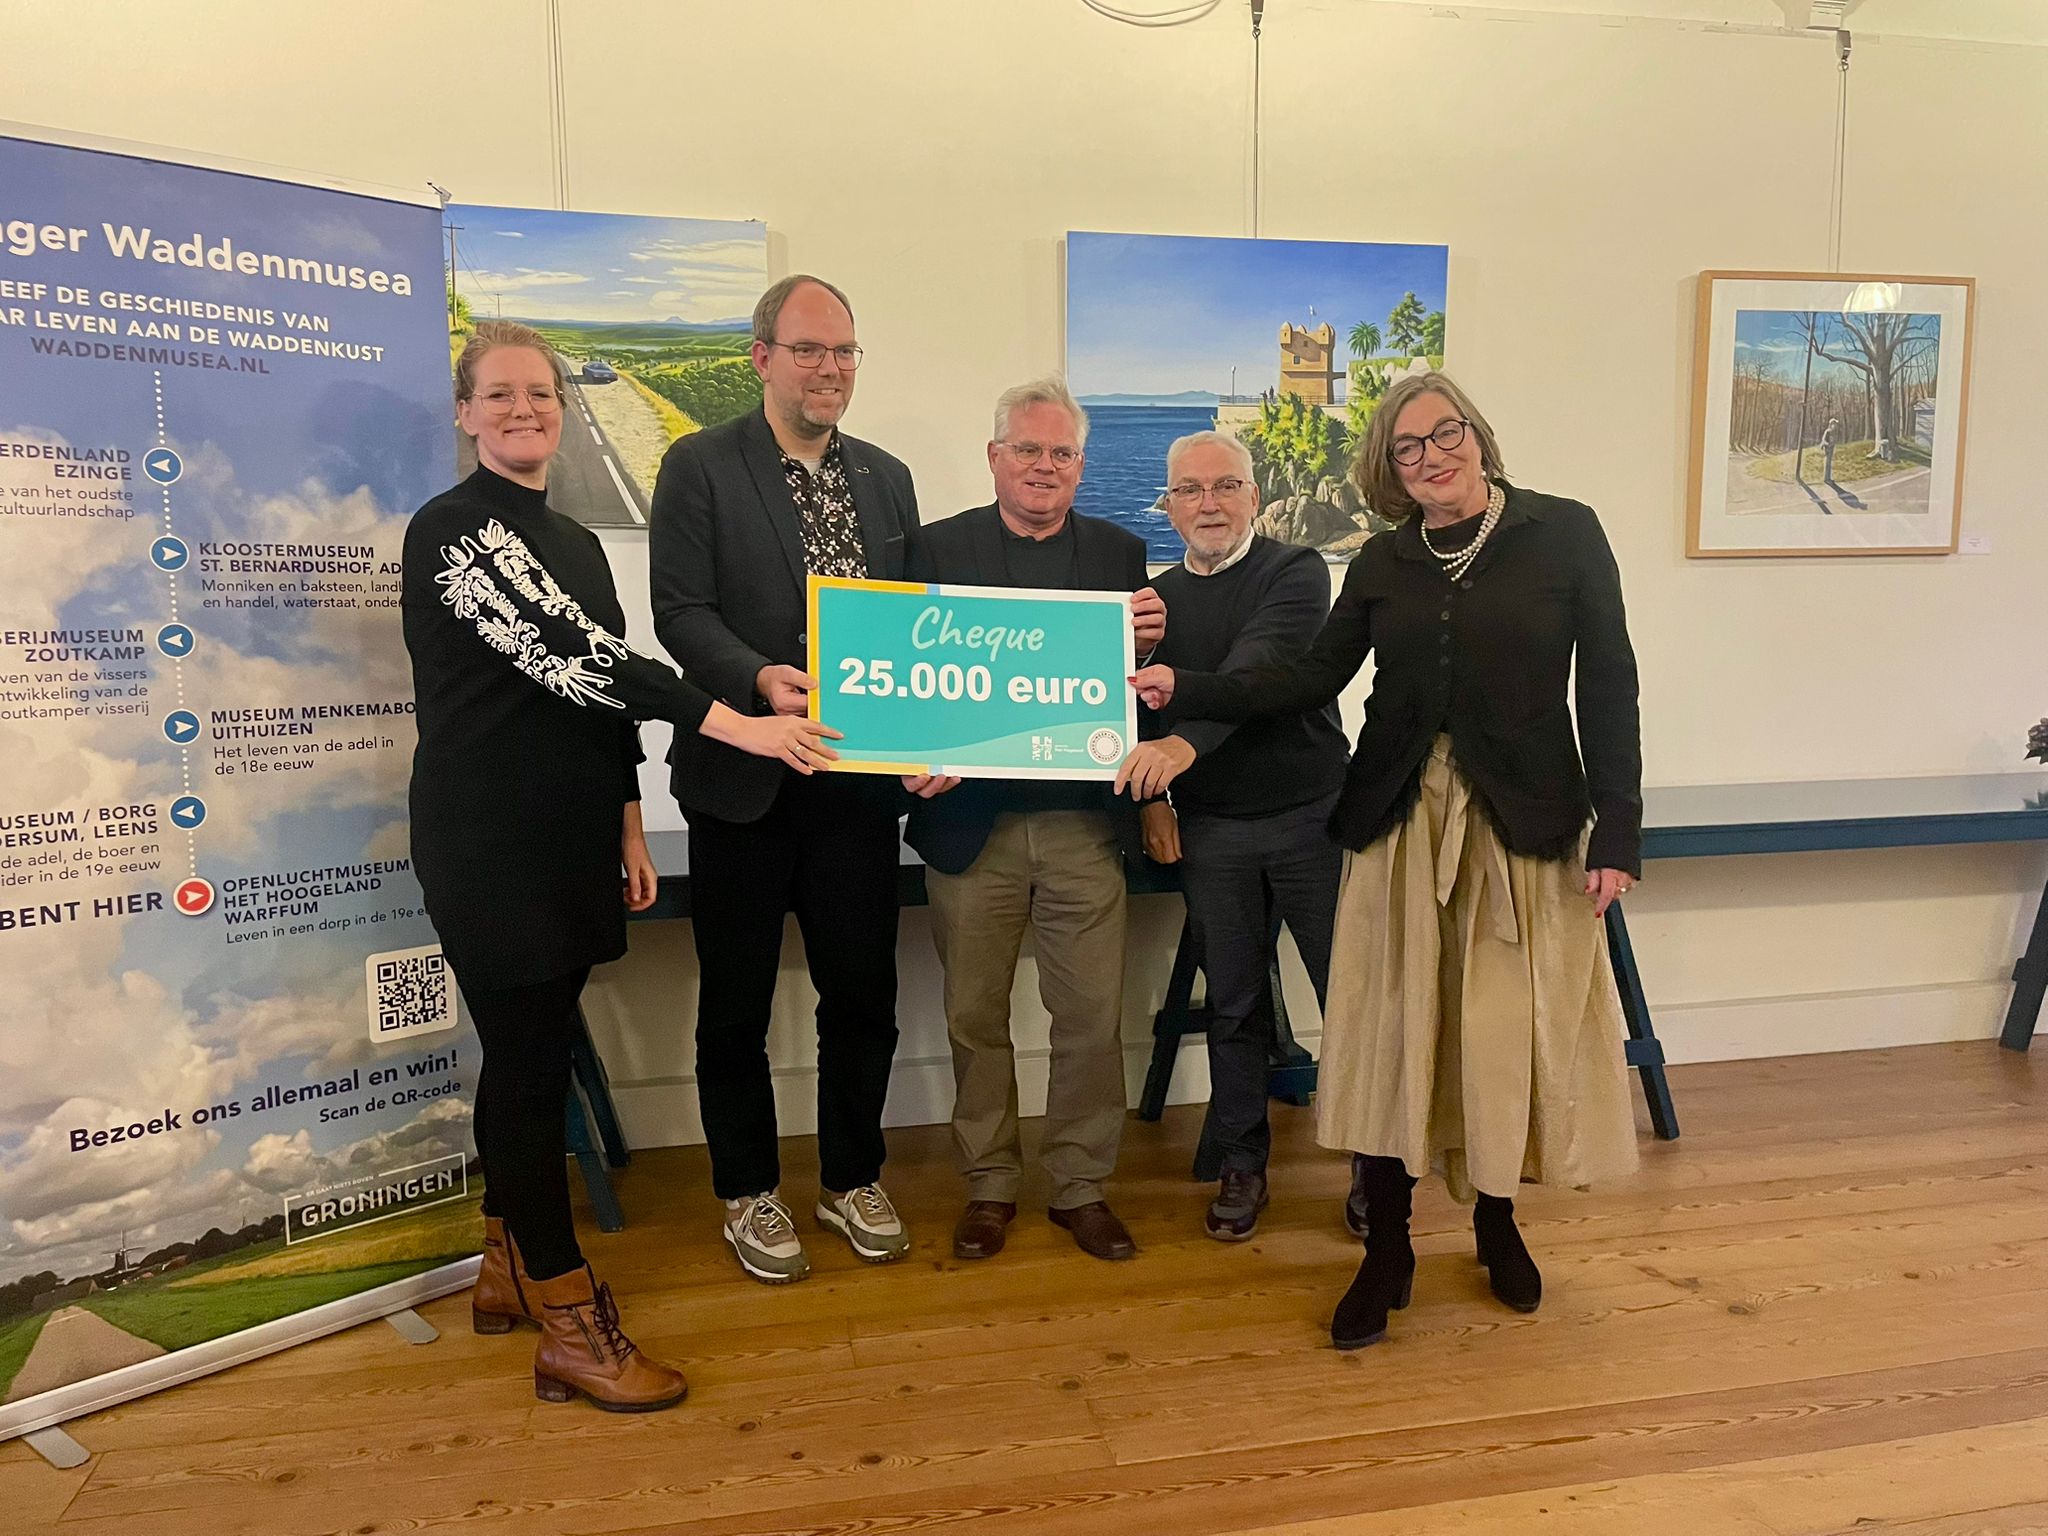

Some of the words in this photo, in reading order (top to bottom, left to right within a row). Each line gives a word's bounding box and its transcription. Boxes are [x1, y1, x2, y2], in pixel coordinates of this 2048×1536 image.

[0, 220, 88, 256] ger
[102, 222, 412, 296] Waddenmusea
[57, 286, 90, 306] DE
[100, 290, 275, 326] GESCHIEDENIS
[283, 312, 329, 333] VAN
[35, 310, 117, 335] LEVEN
[127, 320, 181, 341] AAN
[190, 326, 220, 345] DE
[228, 331, 384, 362] WADDENKUST
[31, 337, 270, 375] WADDENMUSEA.NL
[54, 464, 132, 481] EZINGE
[10, 487, 39, 497] van
[45, 484, 71, 499] het
[77, 486, 134, 501] oudste
[200, 543, 374, 558] KLOOSTERMUSEUM
[200, 559, 224, 572] ST.
[230, 559, 374, 575] BERNARDUSHOF,
[202, 580, 275, 592] Monniken
[278, 582, 297, 592] en
[301, 580, 366, 594] baksteen,
[203, 598, 221, 608] en
[226, 596, 278, 610] handel,
[283, 597, 360, 609] waterstaat,
[911, 606, 1045, 662] Cheque
[25, 647, 145, 662] ZOUTKAMP
[34, 672, 62, 682] van
[69, 669, 89, 682] de
[94, 668, 147, 680] vissers
[839, 657, 992, 701] 25.000
[1007, 675, 1107, 705] euro
[95, 687, 123, 697] van
[128, 684, 148, 696] de
[96, 701, 150, 717] visserij
[211, 707, 294, 724] MUSEUM
[301, 702, 417, 719] MENKEMABO
[212, 723, 313, 740] UITHUIZEN
[214, 745, 243, 759] Het
[248, 743, 289, 757] leven
[293, 743, 319, 754] van
[324, 739, 342, 751] de
[347, 737, 378, 751] adel
[382, 736, 394, 748] in
[214, 762, 234, 775] de
[241, 761, 268, 774] 18e
[273, 760, 314, 771] eeuw
[99, 804, 157, 821] BORG
[0, 828, 84, 847] ERSUM,
[94, 821, 159, 839] LEENS
[1, 855, 22, 869] de
[28, 850, 67, 866] adel,
[73, 848, 93, 861] de
[99, 844, 136, 858] boer
[140, 843, 160, 854] en
[39, 870, 53, 882] in
[59, 866, 79, 880] de
[85, 863, 114, 876] 19e
[118, 859, 161, 873] eeuw
[223, 858, 410, 893] OPENLUCHTMUSEUM
[224, 893, 261, 909] HET
[266, 878, 382, 905] HOOGELAND
[0, 901, 80, 931] BENT
[93, 892, 164, 919] HIER
[224, 901, 319, 926] WARFFUM
[226, 930, 269, 945] Leven
[273, 926, 285, 939] in
[289, 924, 315, 936] een
[319, 918, 351, 931] dorp
[355, 914, 366, 925] in
[371, 911, 387, 923] de
[392, 908, 414, 919] 19e
[70, 1108, 182, 1152] Bezoek
[191, 1102, 242, 1126] ons
[251, 1069, 359, 1113] allemaal
[368, 1068, 399, 1086] en
[407, 1050, 458, 1078] win!
[319, 1102, 359, 1123] Scan
[364, 1097, 386, 1113] de
[391, 1080, 462, 1106] QR-code
[301, 1170, 453, 1227] GRONINGEN
